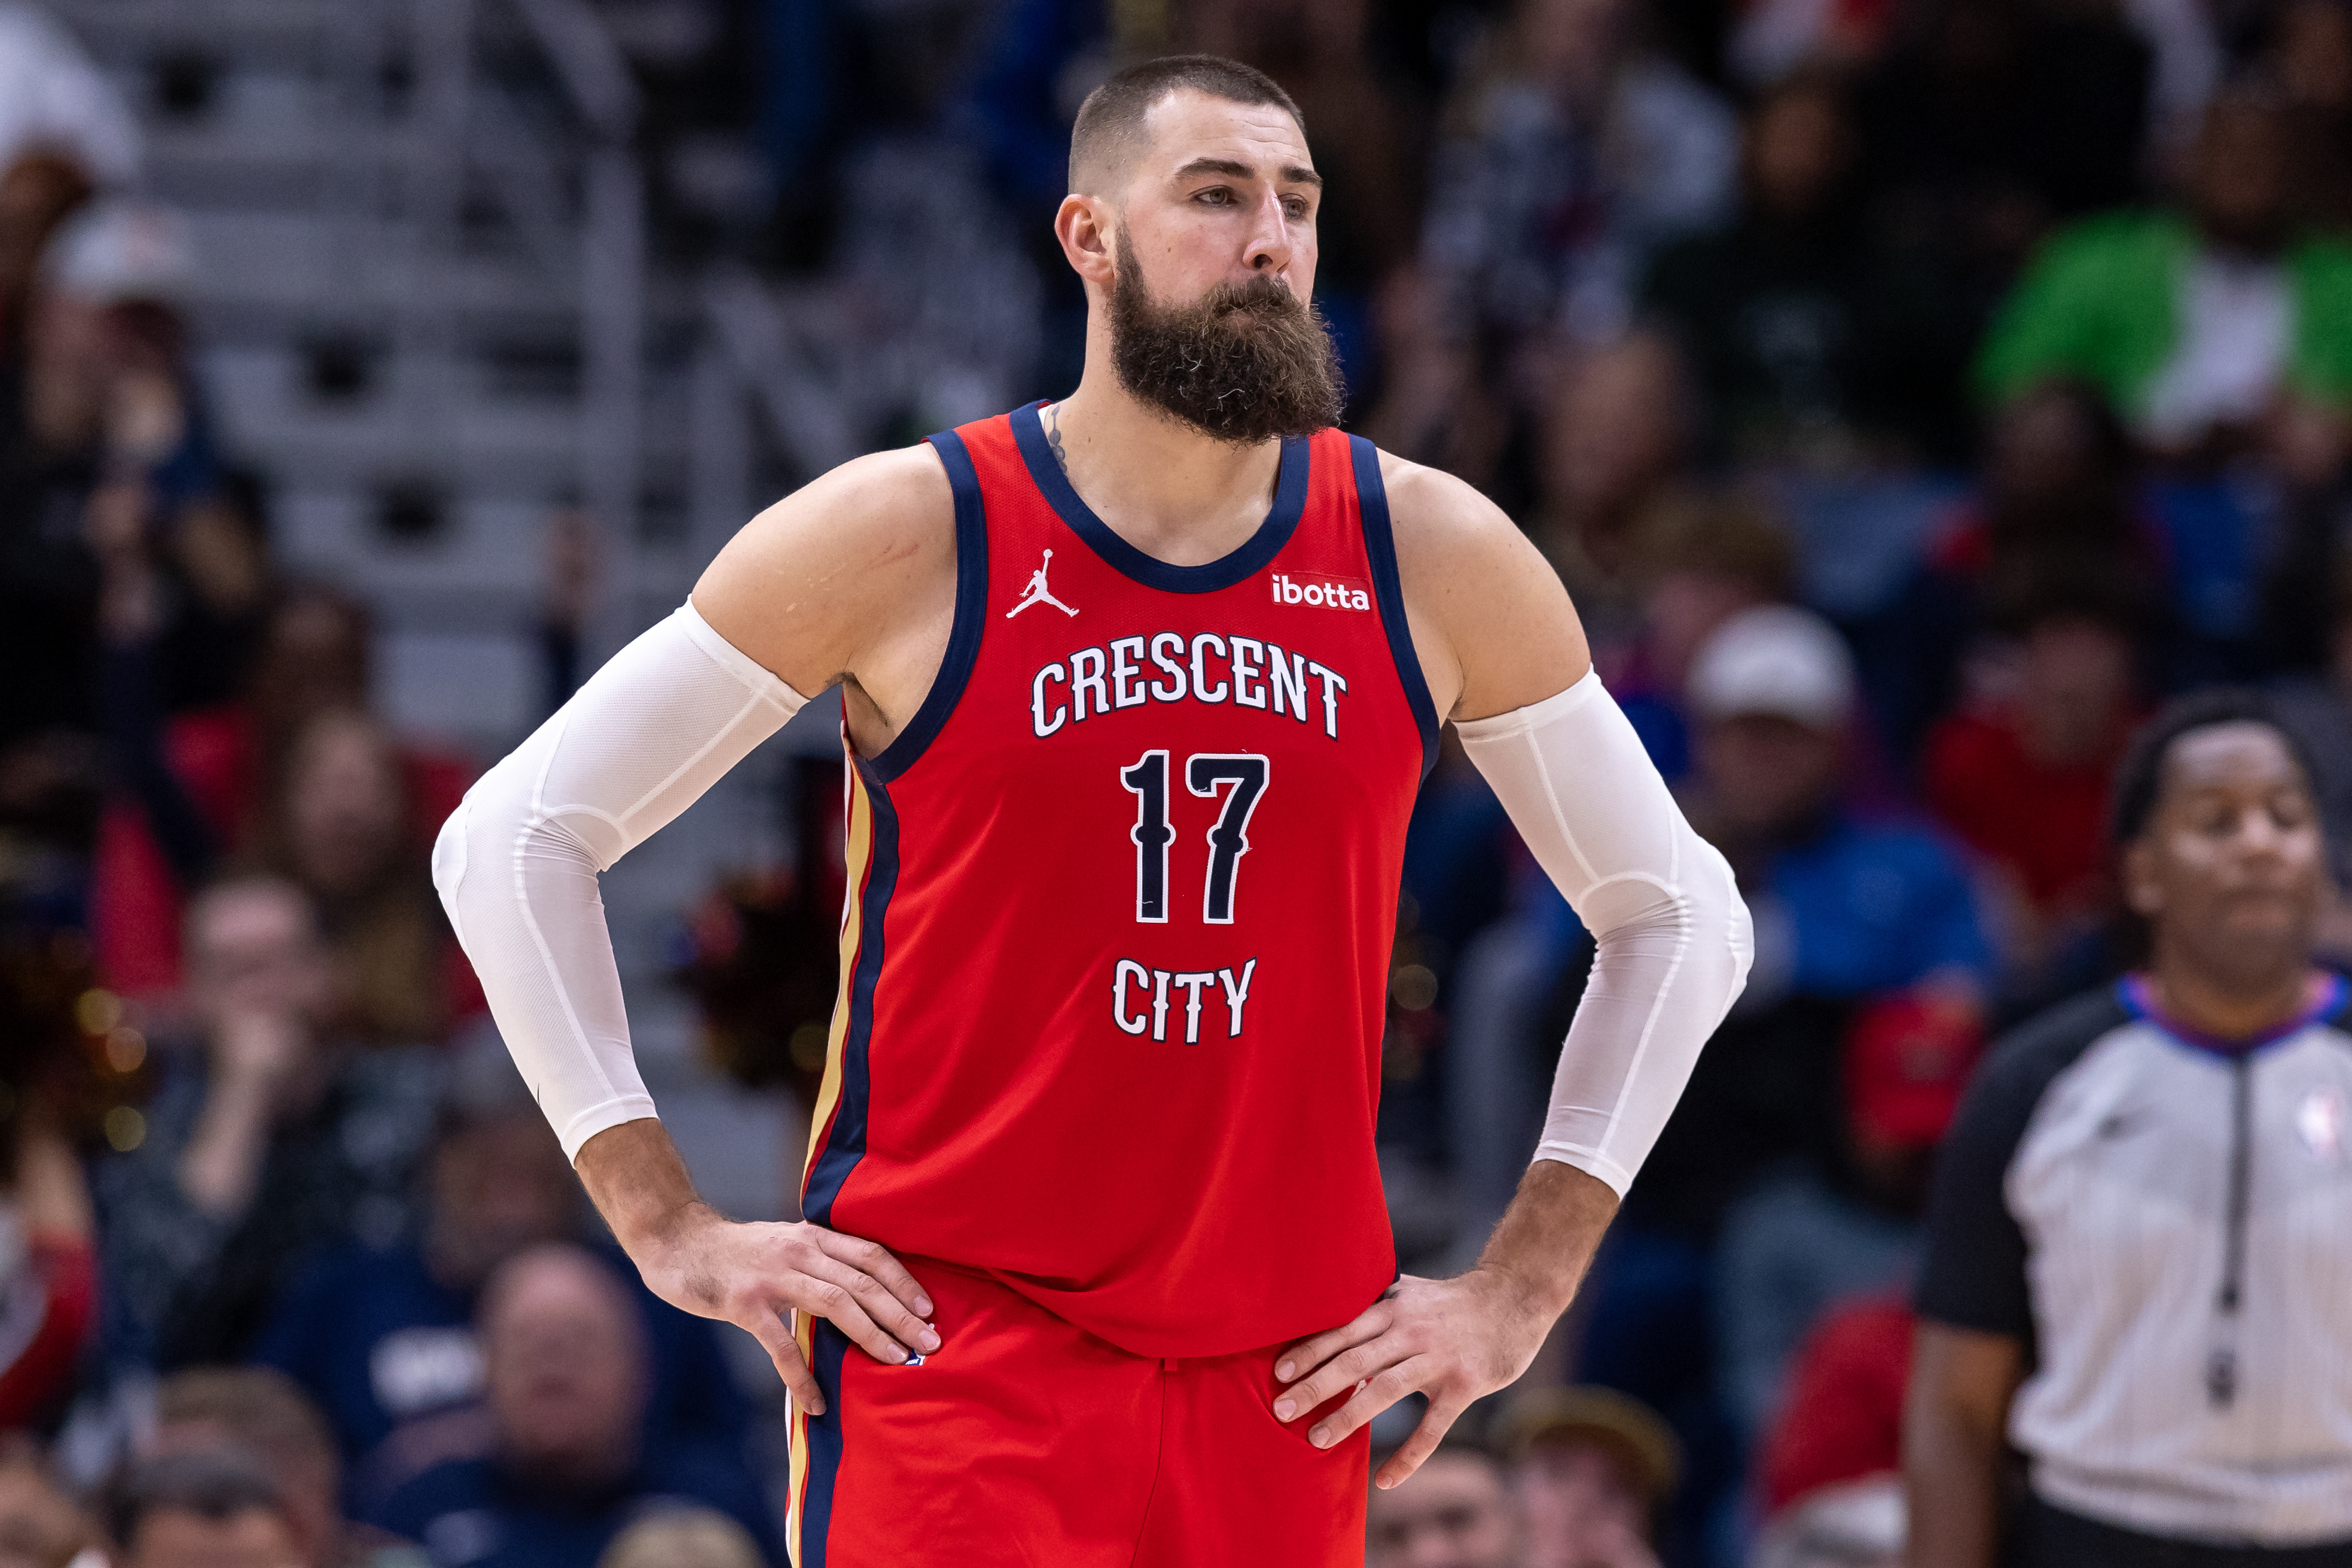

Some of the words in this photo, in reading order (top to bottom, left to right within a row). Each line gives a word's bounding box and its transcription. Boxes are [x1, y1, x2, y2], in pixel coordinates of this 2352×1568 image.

[1272, 573, 1370, 611] ibotta
[1030, 631, 1348, 740] CRESCENT
[1120, 749, 1270, 925] 17
[1111, 956, 1257, 1045] CITY
